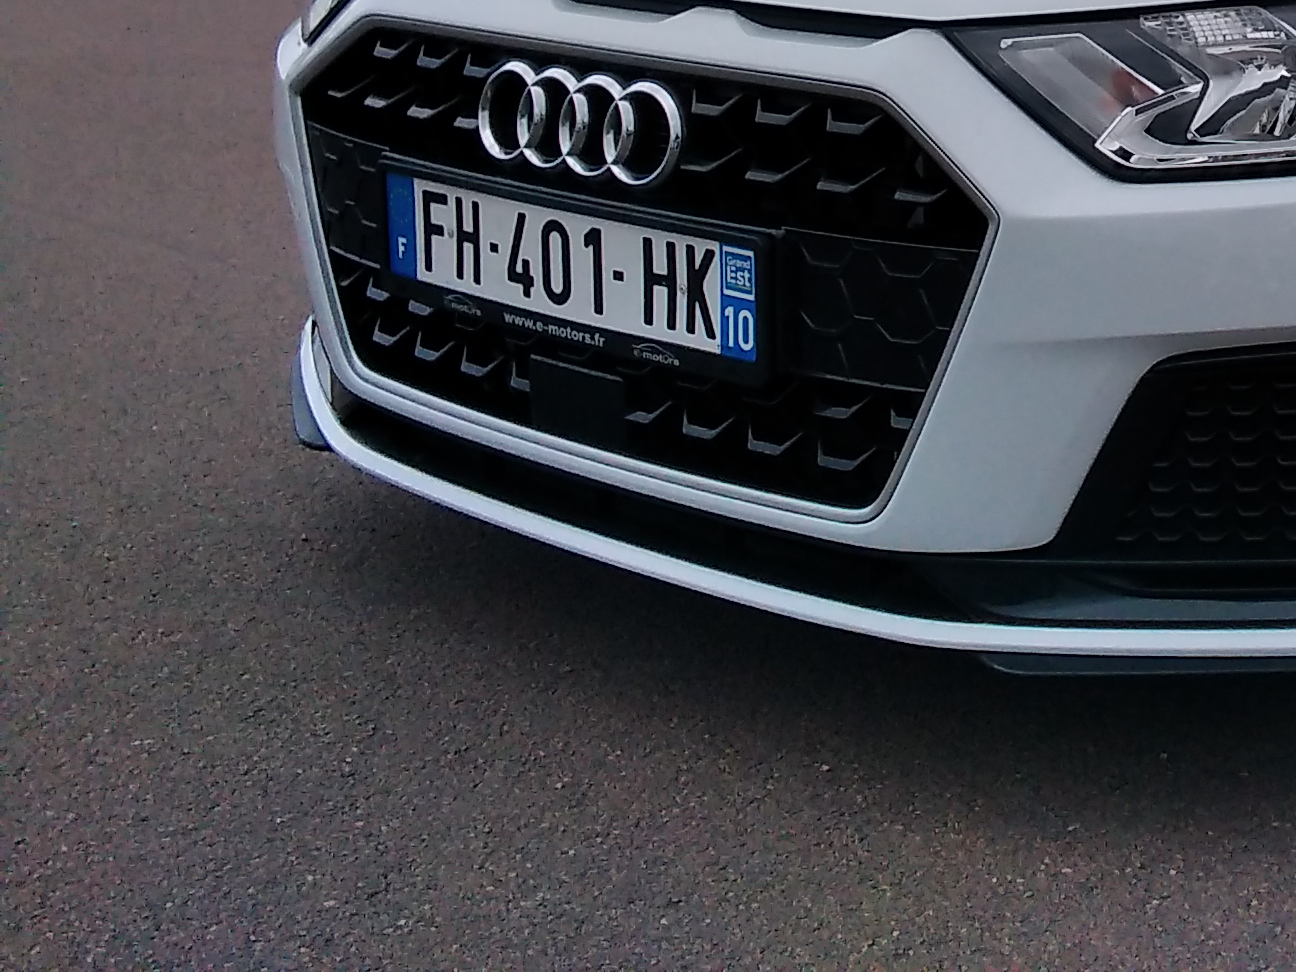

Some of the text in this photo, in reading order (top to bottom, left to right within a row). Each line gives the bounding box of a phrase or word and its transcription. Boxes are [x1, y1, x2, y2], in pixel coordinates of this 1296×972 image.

[398, 236, 407, 259] F
[726, 256, 751, 269] Grand
[421, 189, 717, 341] FH-401-HK
[727, 266, 751, 287] Est
[503, 311, 606, 348] www.e-motors.fr
[724, 306, 754, 351] 10
